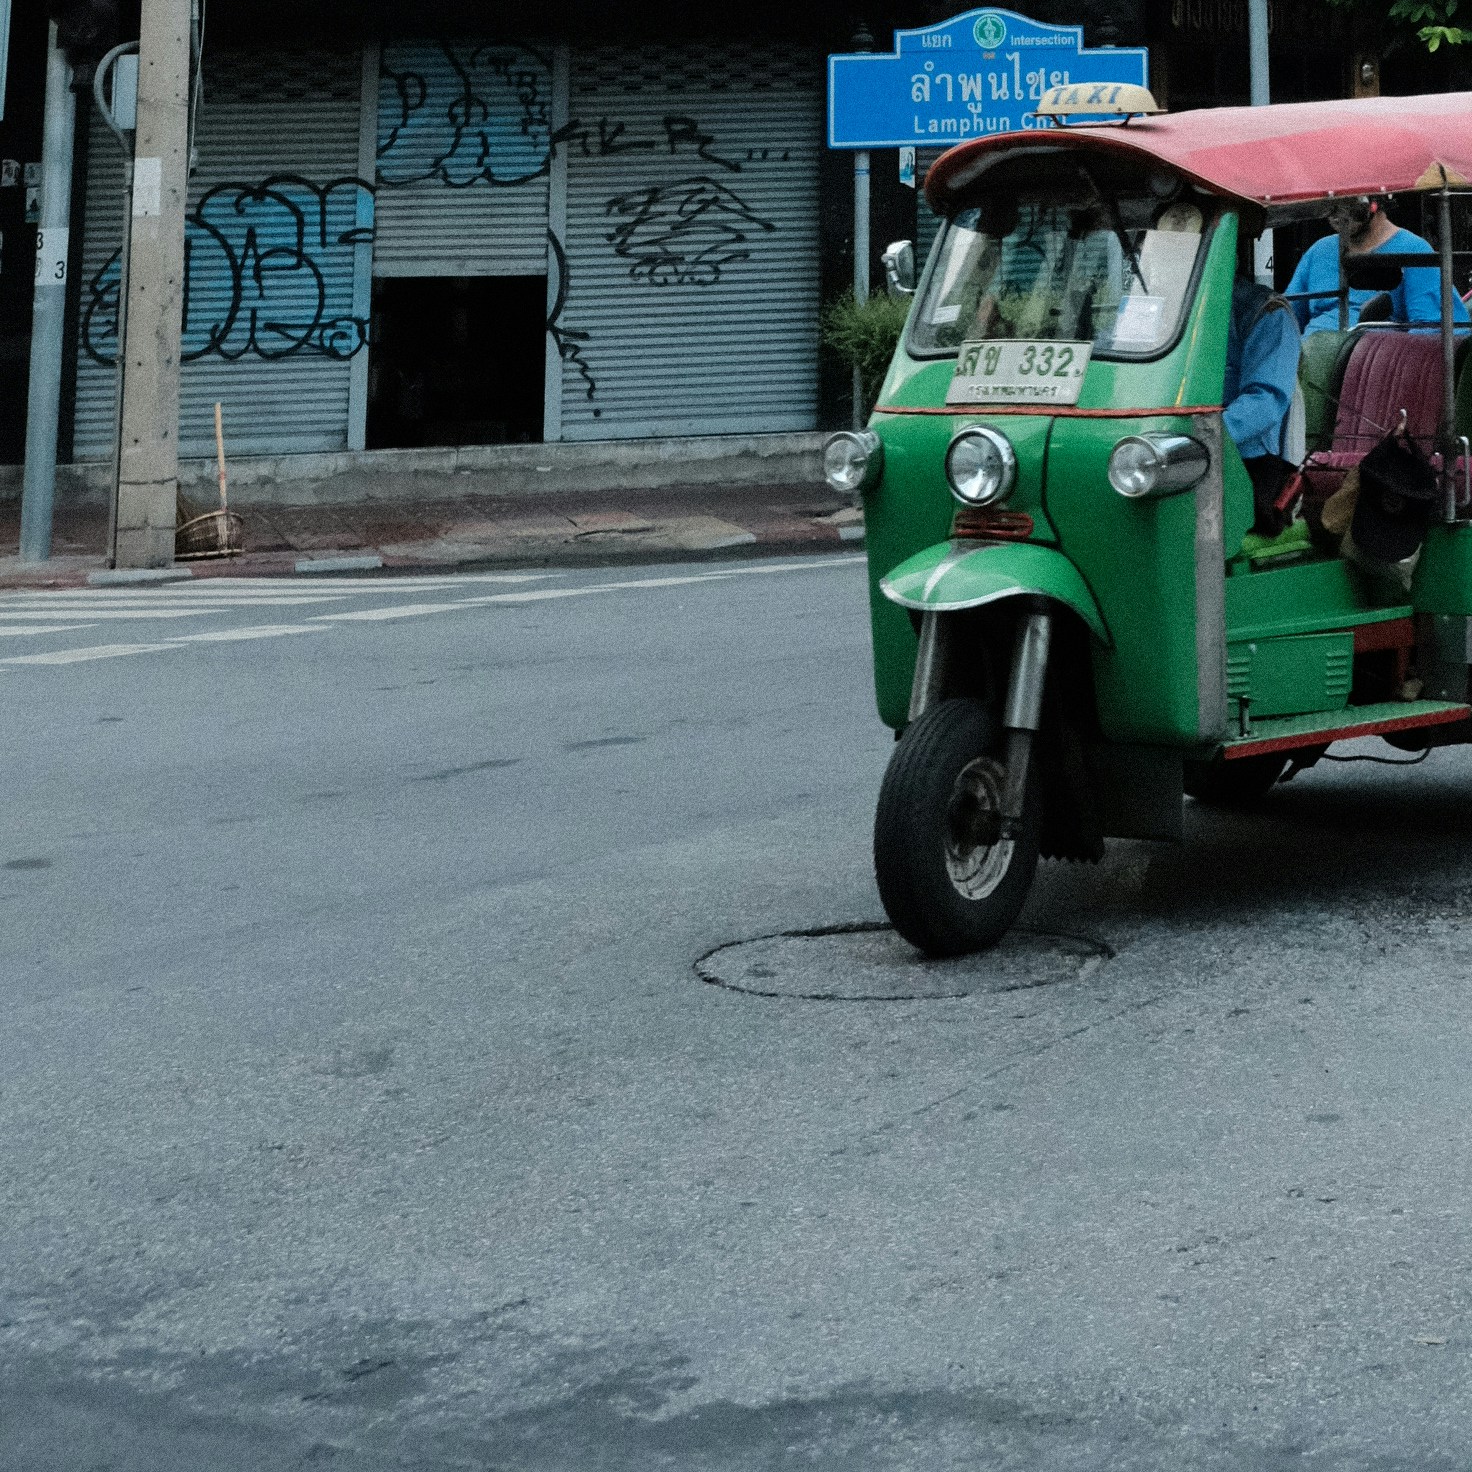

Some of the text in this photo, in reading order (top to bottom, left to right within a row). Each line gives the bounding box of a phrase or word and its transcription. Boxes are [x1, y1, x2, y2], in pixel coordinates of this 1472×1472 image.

[922, 33, 952, 48] แยก
[1010, 34, 1075, 47] Intersection
[1050, 85, 1122, 106] TAXI
[914, 114, 1010, 137] Lamphun
[1018, 345, 1074, 377] 332
